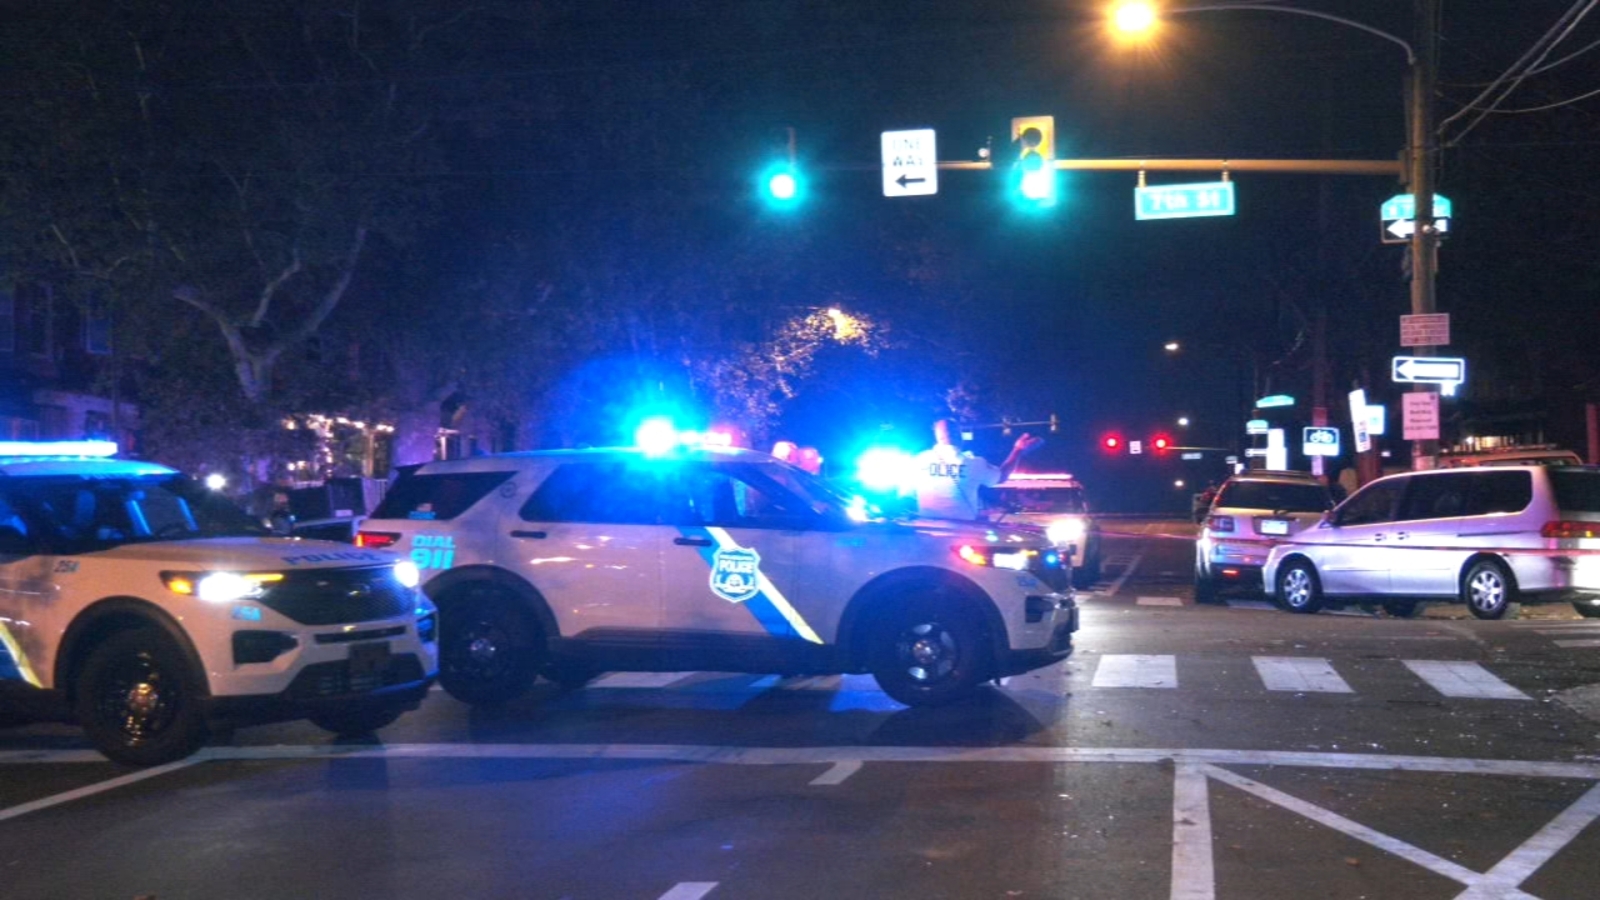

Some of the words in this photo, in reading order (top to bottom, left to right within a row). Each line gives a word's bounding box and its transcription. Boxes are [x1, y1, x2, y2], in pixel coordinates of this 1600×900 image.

[892, 138, 920, 151] ONE
[893, 154, 924, 168] WAY
[1149, 192, 1187, 210] 7th
[1199, 190, 1220, 208] St
[921, 463, 967, 479] OLICE
[412, 535, 456, 549] DIAL
[283, 552, 381, 565] POLICE
[410, 548, 454, 570] 911
[718, 560, 756, 573] POLICE
